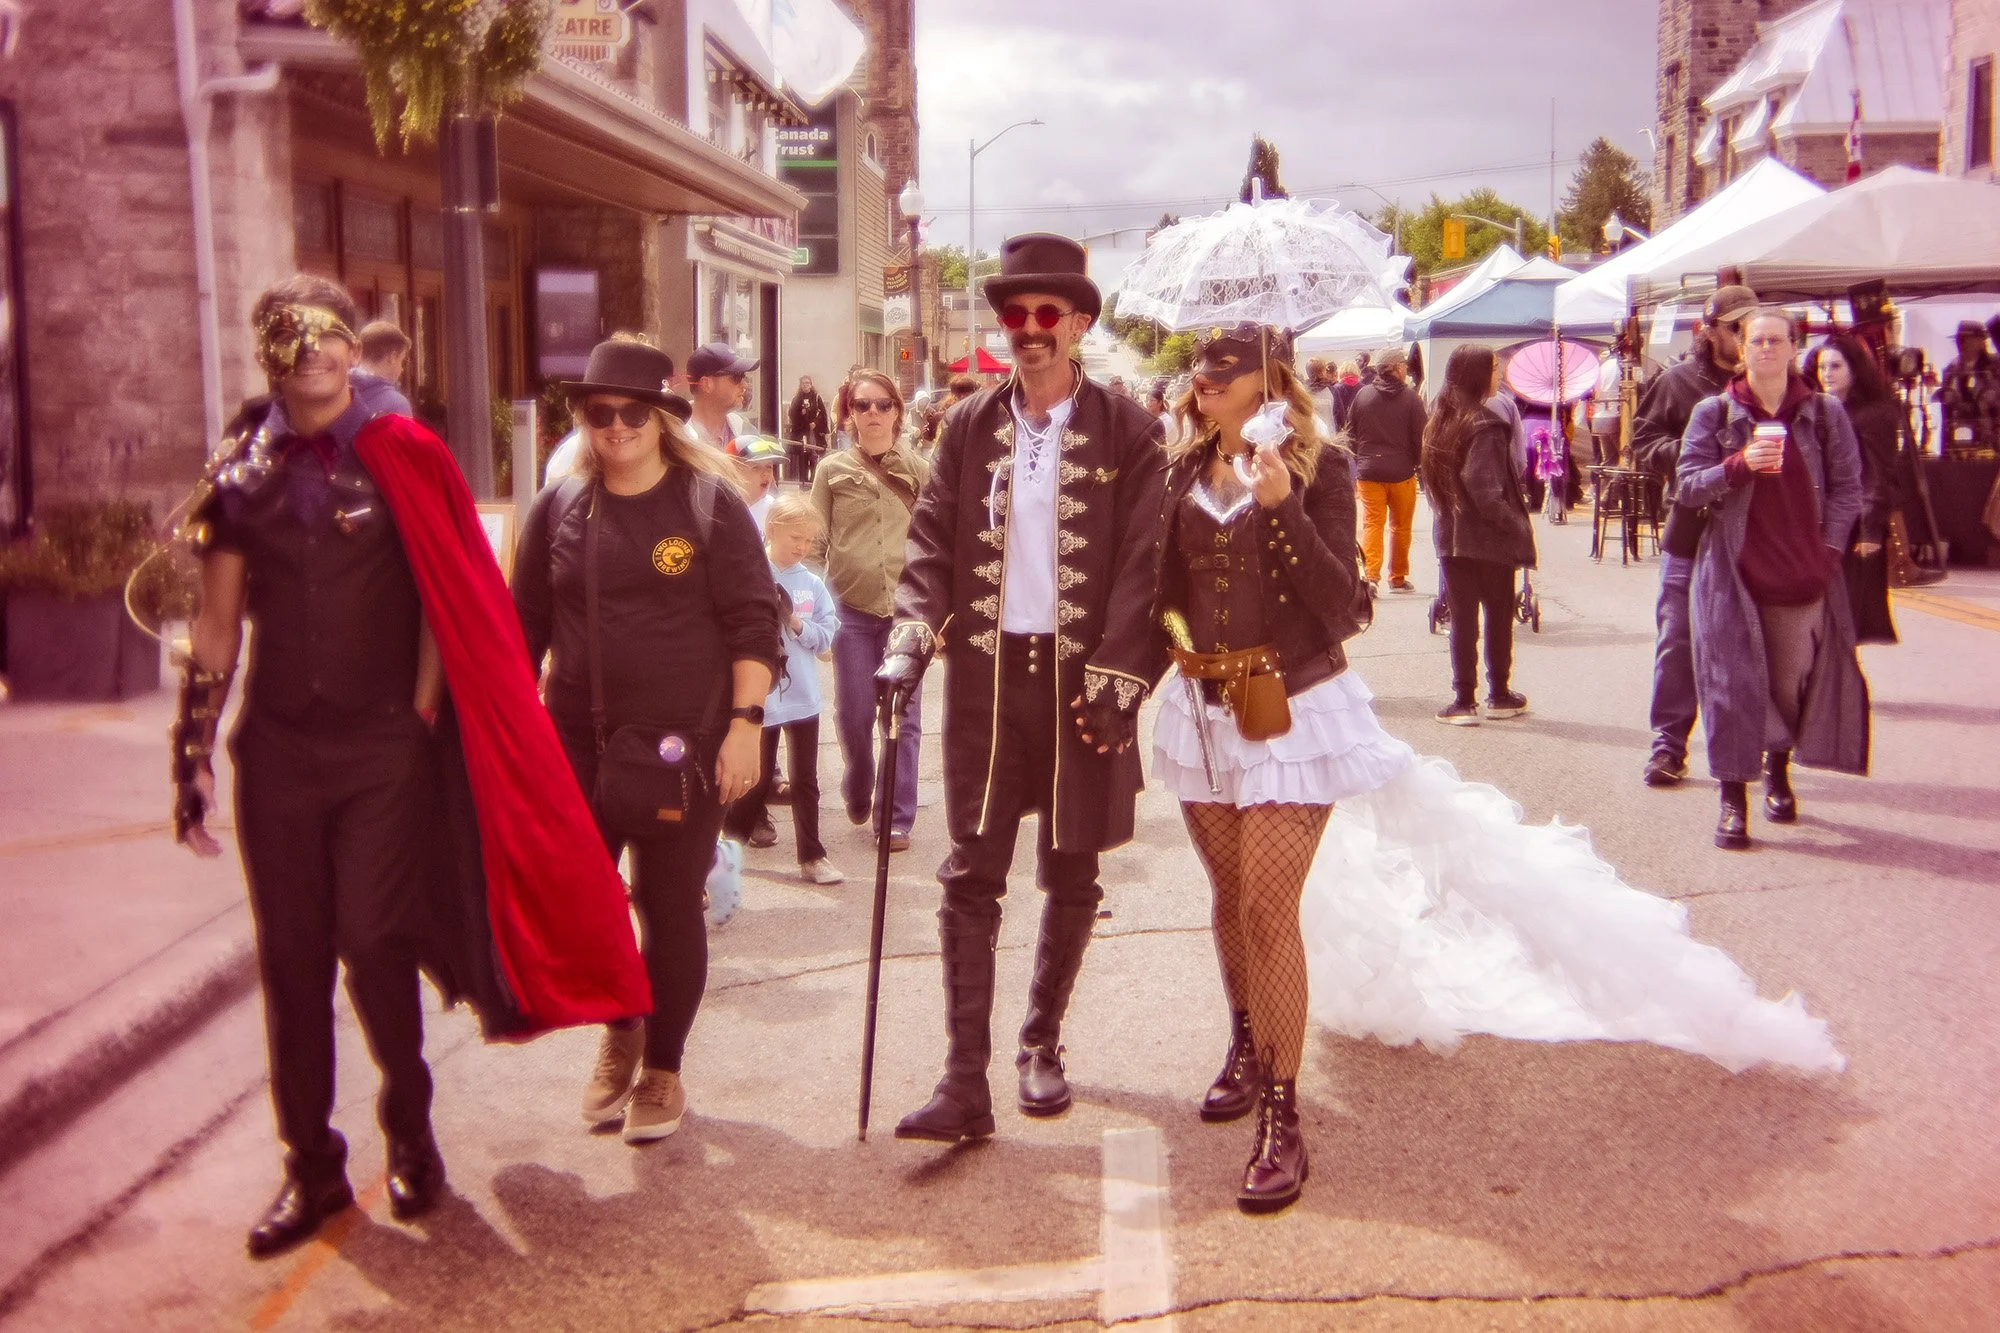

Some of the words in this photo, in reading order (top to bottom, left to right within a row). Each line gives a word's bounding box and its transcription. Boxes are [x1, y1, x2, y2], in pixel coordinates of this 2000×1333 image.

[656, 542, 668, 556] TWO
[668, 539, 691, 554] LOONS
[657, 558, 688, 573] BREWING
